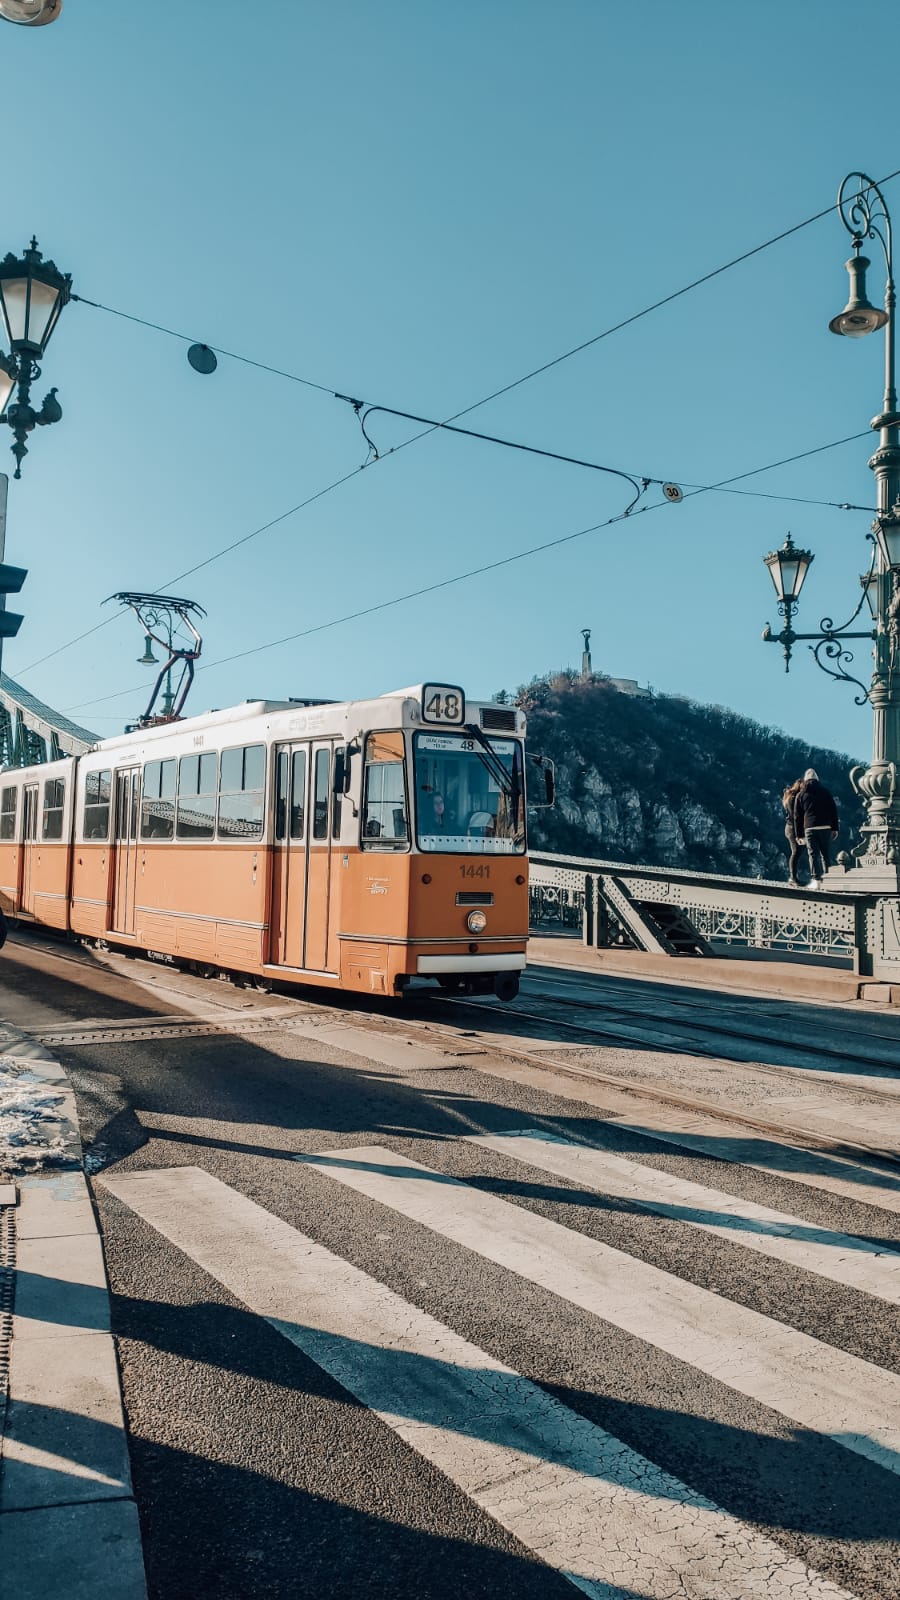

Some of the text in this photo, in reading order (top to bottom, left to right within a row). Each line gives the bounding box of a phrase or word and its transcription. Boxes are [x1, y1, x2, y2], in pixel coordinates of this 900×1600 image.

[666, 487, 679, 497] 30
[426, 693, 459, 719] 48
[460, 740, 474, 751] 48
[459, 864, 490, 879] 1441
